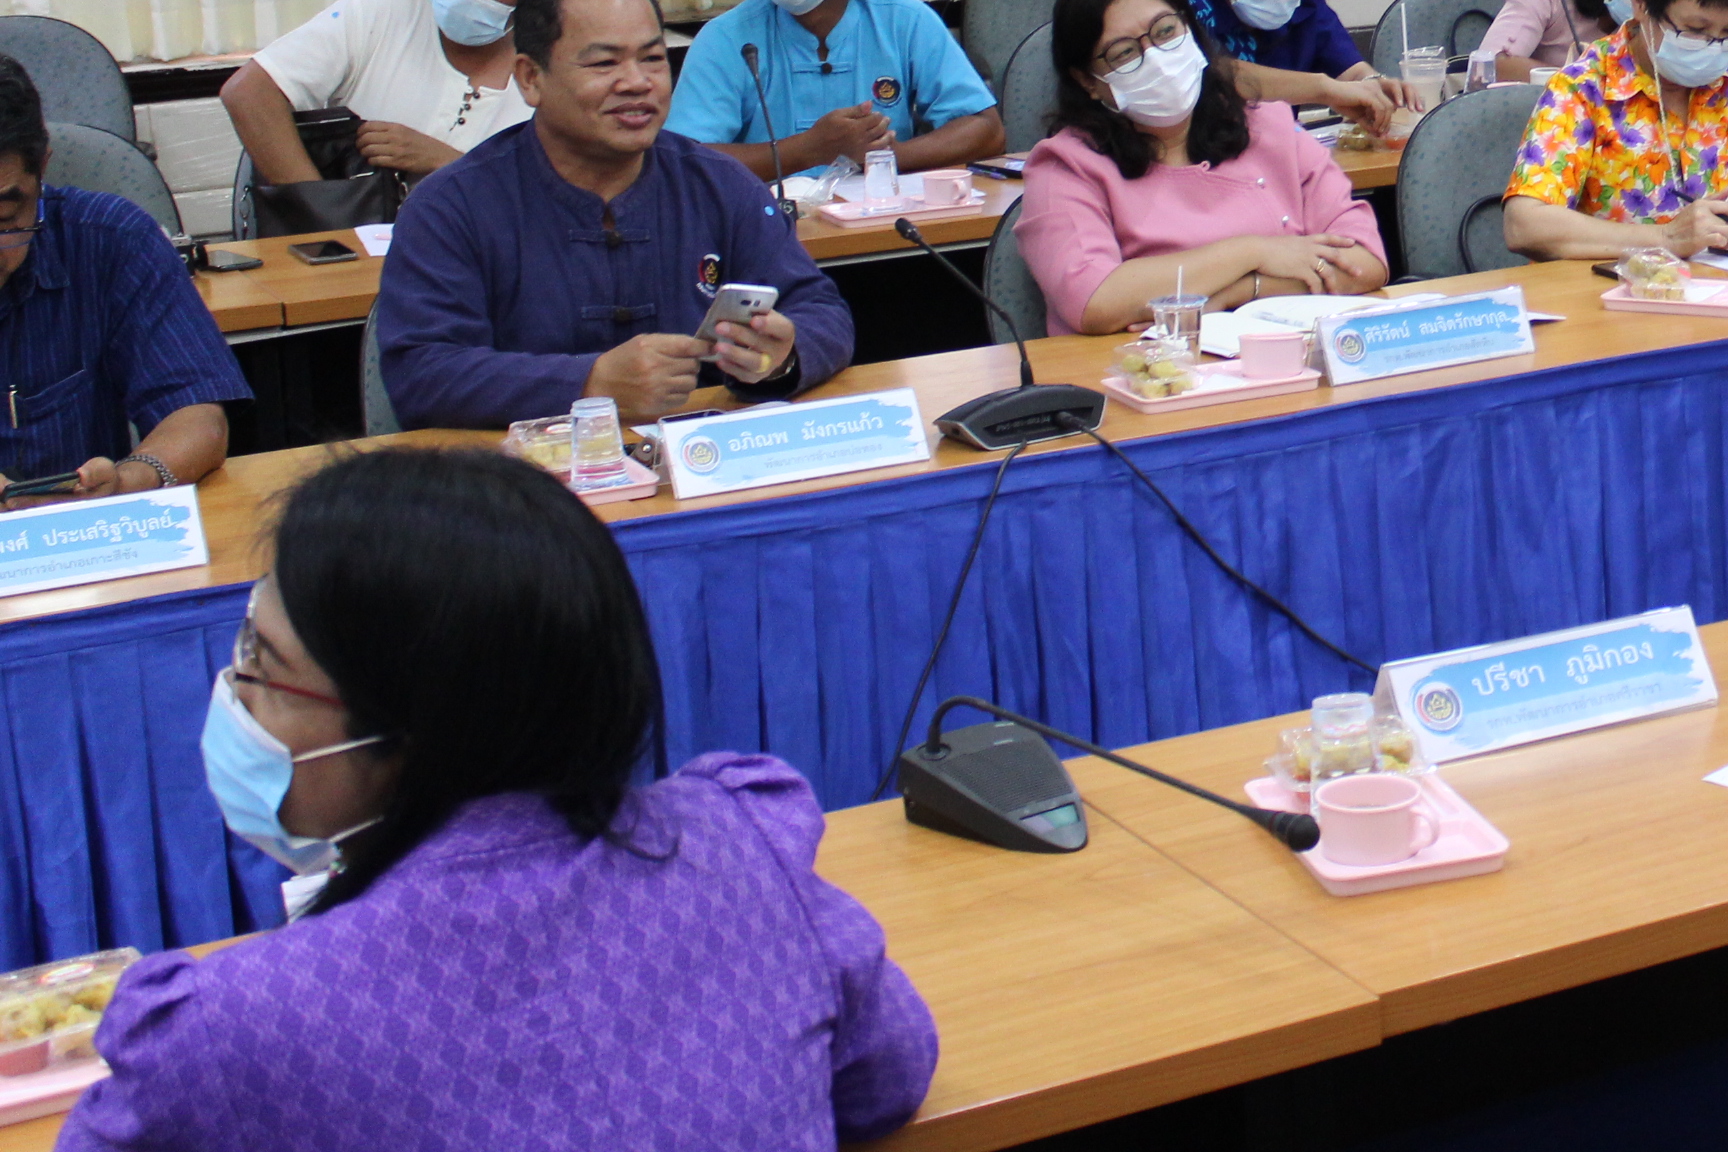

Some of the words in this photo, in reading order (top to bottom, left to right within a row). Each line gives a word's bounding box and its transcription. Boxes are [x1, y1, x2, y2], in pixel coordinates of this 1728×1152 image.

[801, 412, 884, 441] มังกรแก้ว
[1471, 660, 1546, 697] ปรีชา
[1566, 641, 1654, 685] ภูมิกอง
